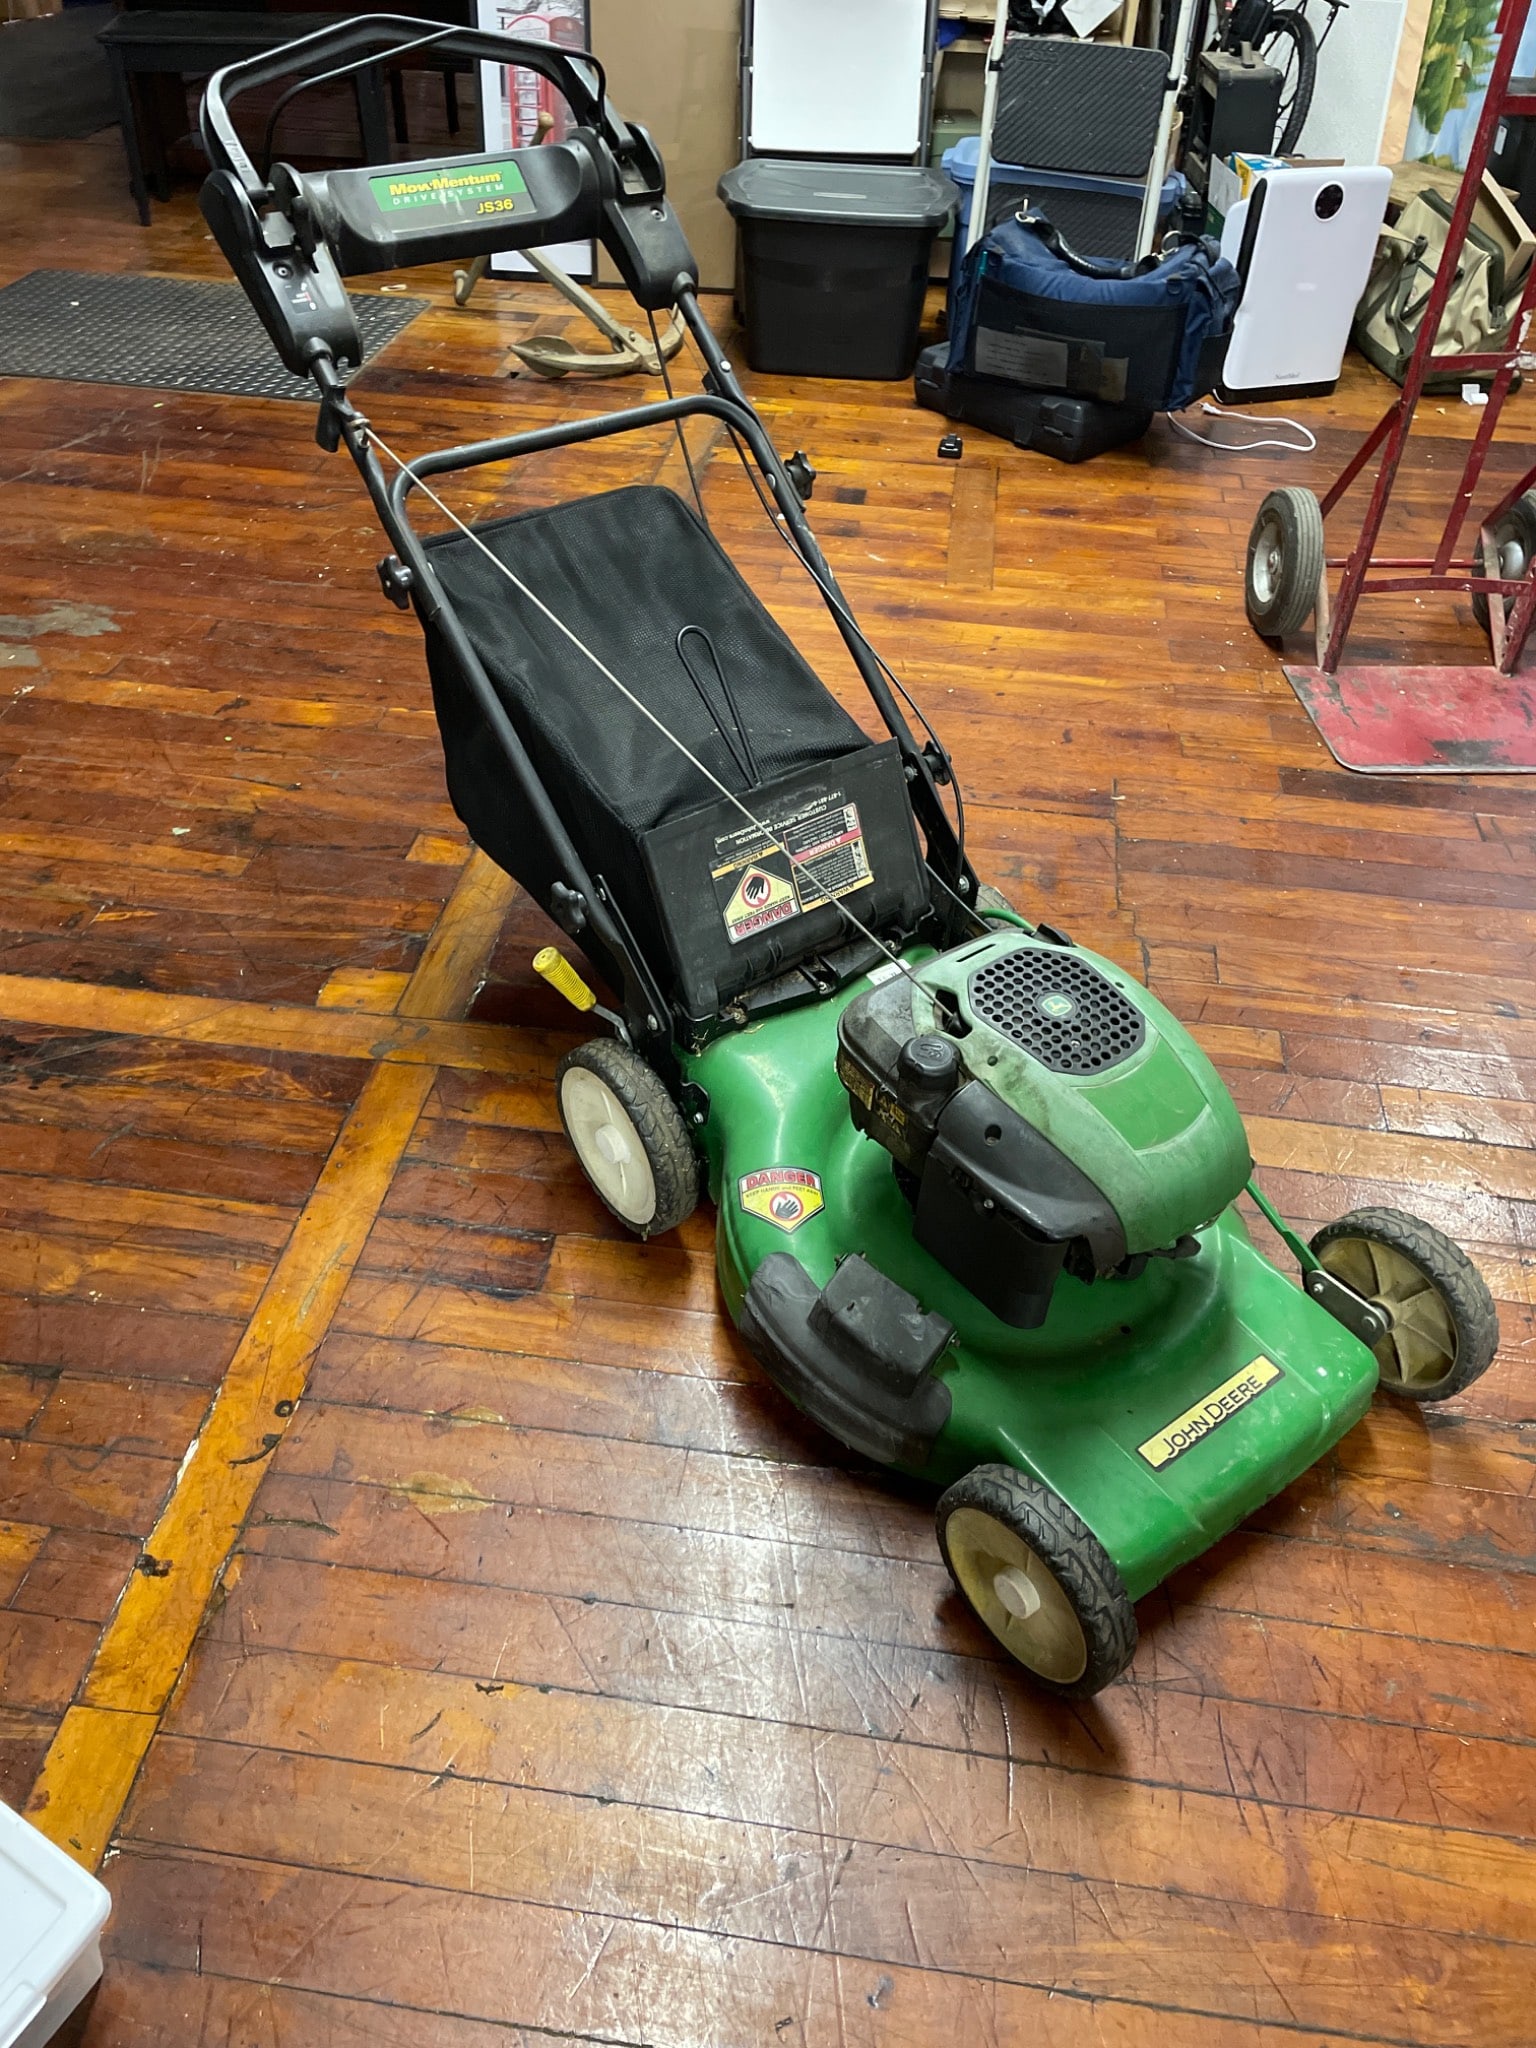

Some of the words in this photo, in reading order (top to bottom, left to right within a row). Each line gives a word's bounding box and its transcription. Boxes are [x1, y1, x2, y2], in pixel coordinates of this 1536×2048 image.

[393, 192, 437, 206] DRIVE
[447, 183, 505, 199] SYSTEM
[476, 198, 514, 215] JS36
[798, 804, 827, 821] CUSTOMER
[773, 816, 797, 831] SERVICE
[809, 841, 836, 856] DANGER
[821, 887, 849, 904] WARNNG
[735, 902, 793, 936] DANGER
[746, 1170, 816, 1190] DANGER
[1162, 1415, 1211, 1456] JOHN
[1203, 1375, 1263, 1420] DEERE
